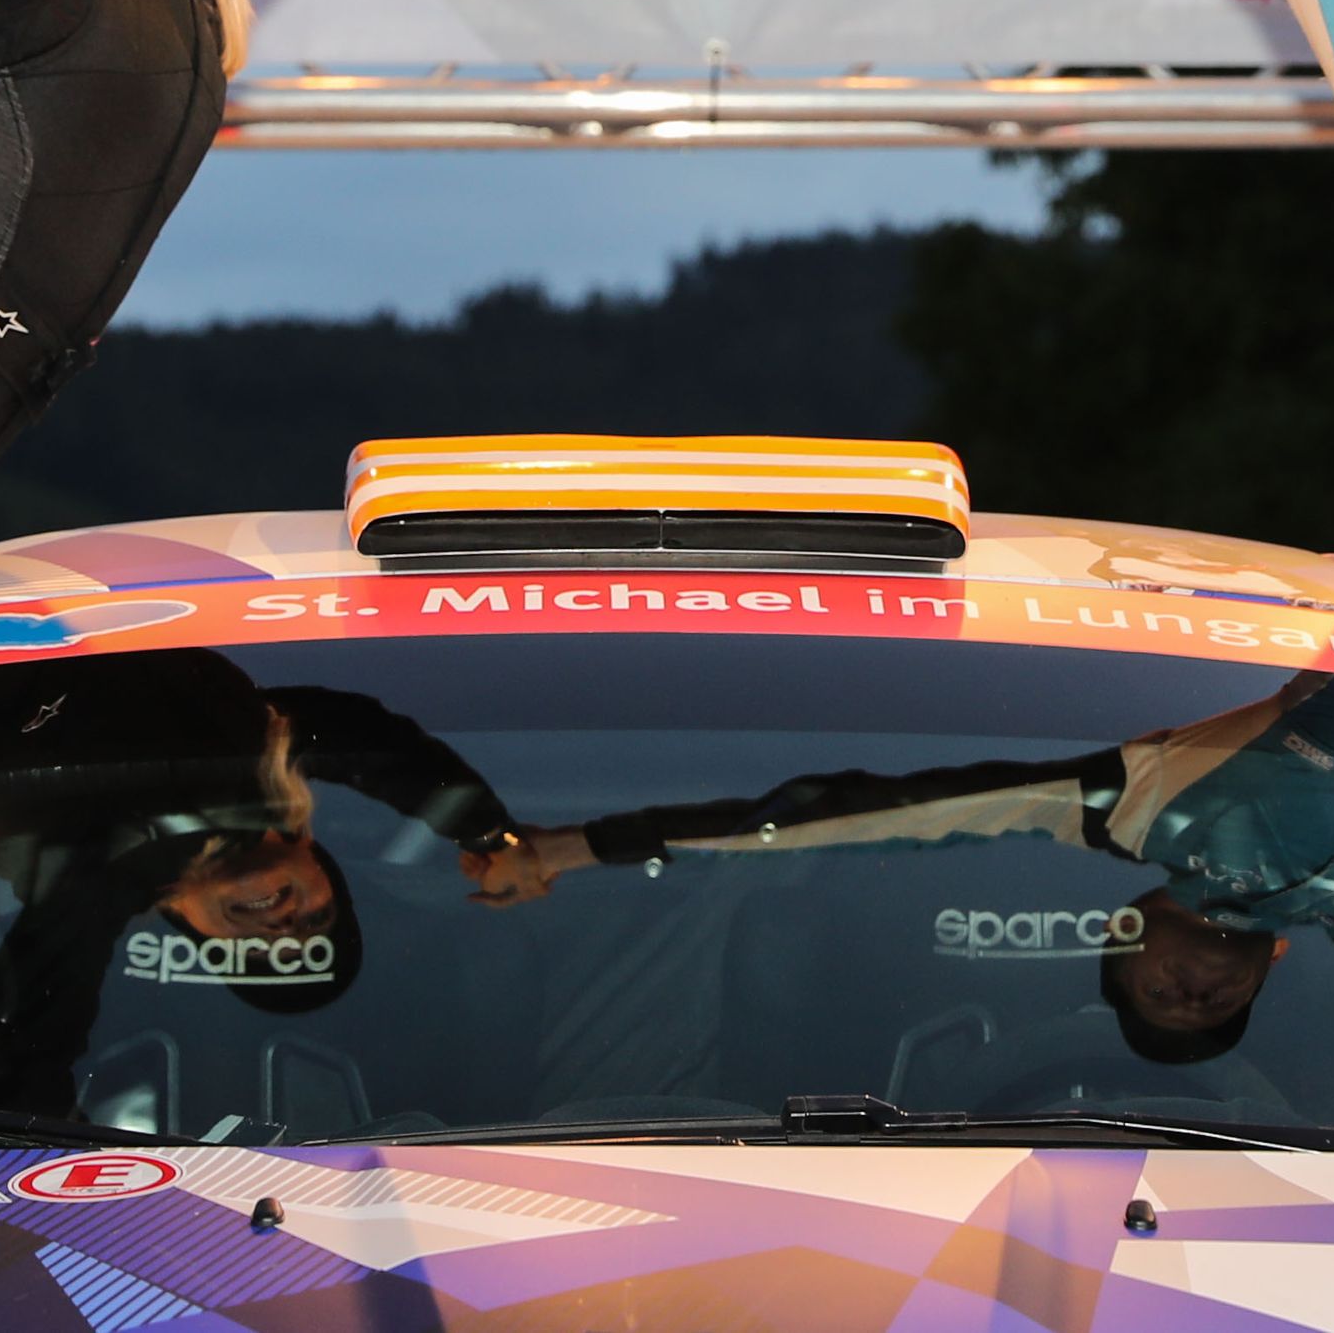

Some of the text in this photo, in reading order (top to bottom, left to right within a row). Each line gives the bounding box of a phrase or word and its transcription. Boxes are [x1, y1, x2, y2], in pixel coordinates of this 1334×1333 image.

[242, 592, 379, 622] St.
[421, 582, 830, 614] Michael
[867, 587, 980, 619] im
[124, 927, 335, 984] sparco
[934, 904, 1145, 958] sparco
